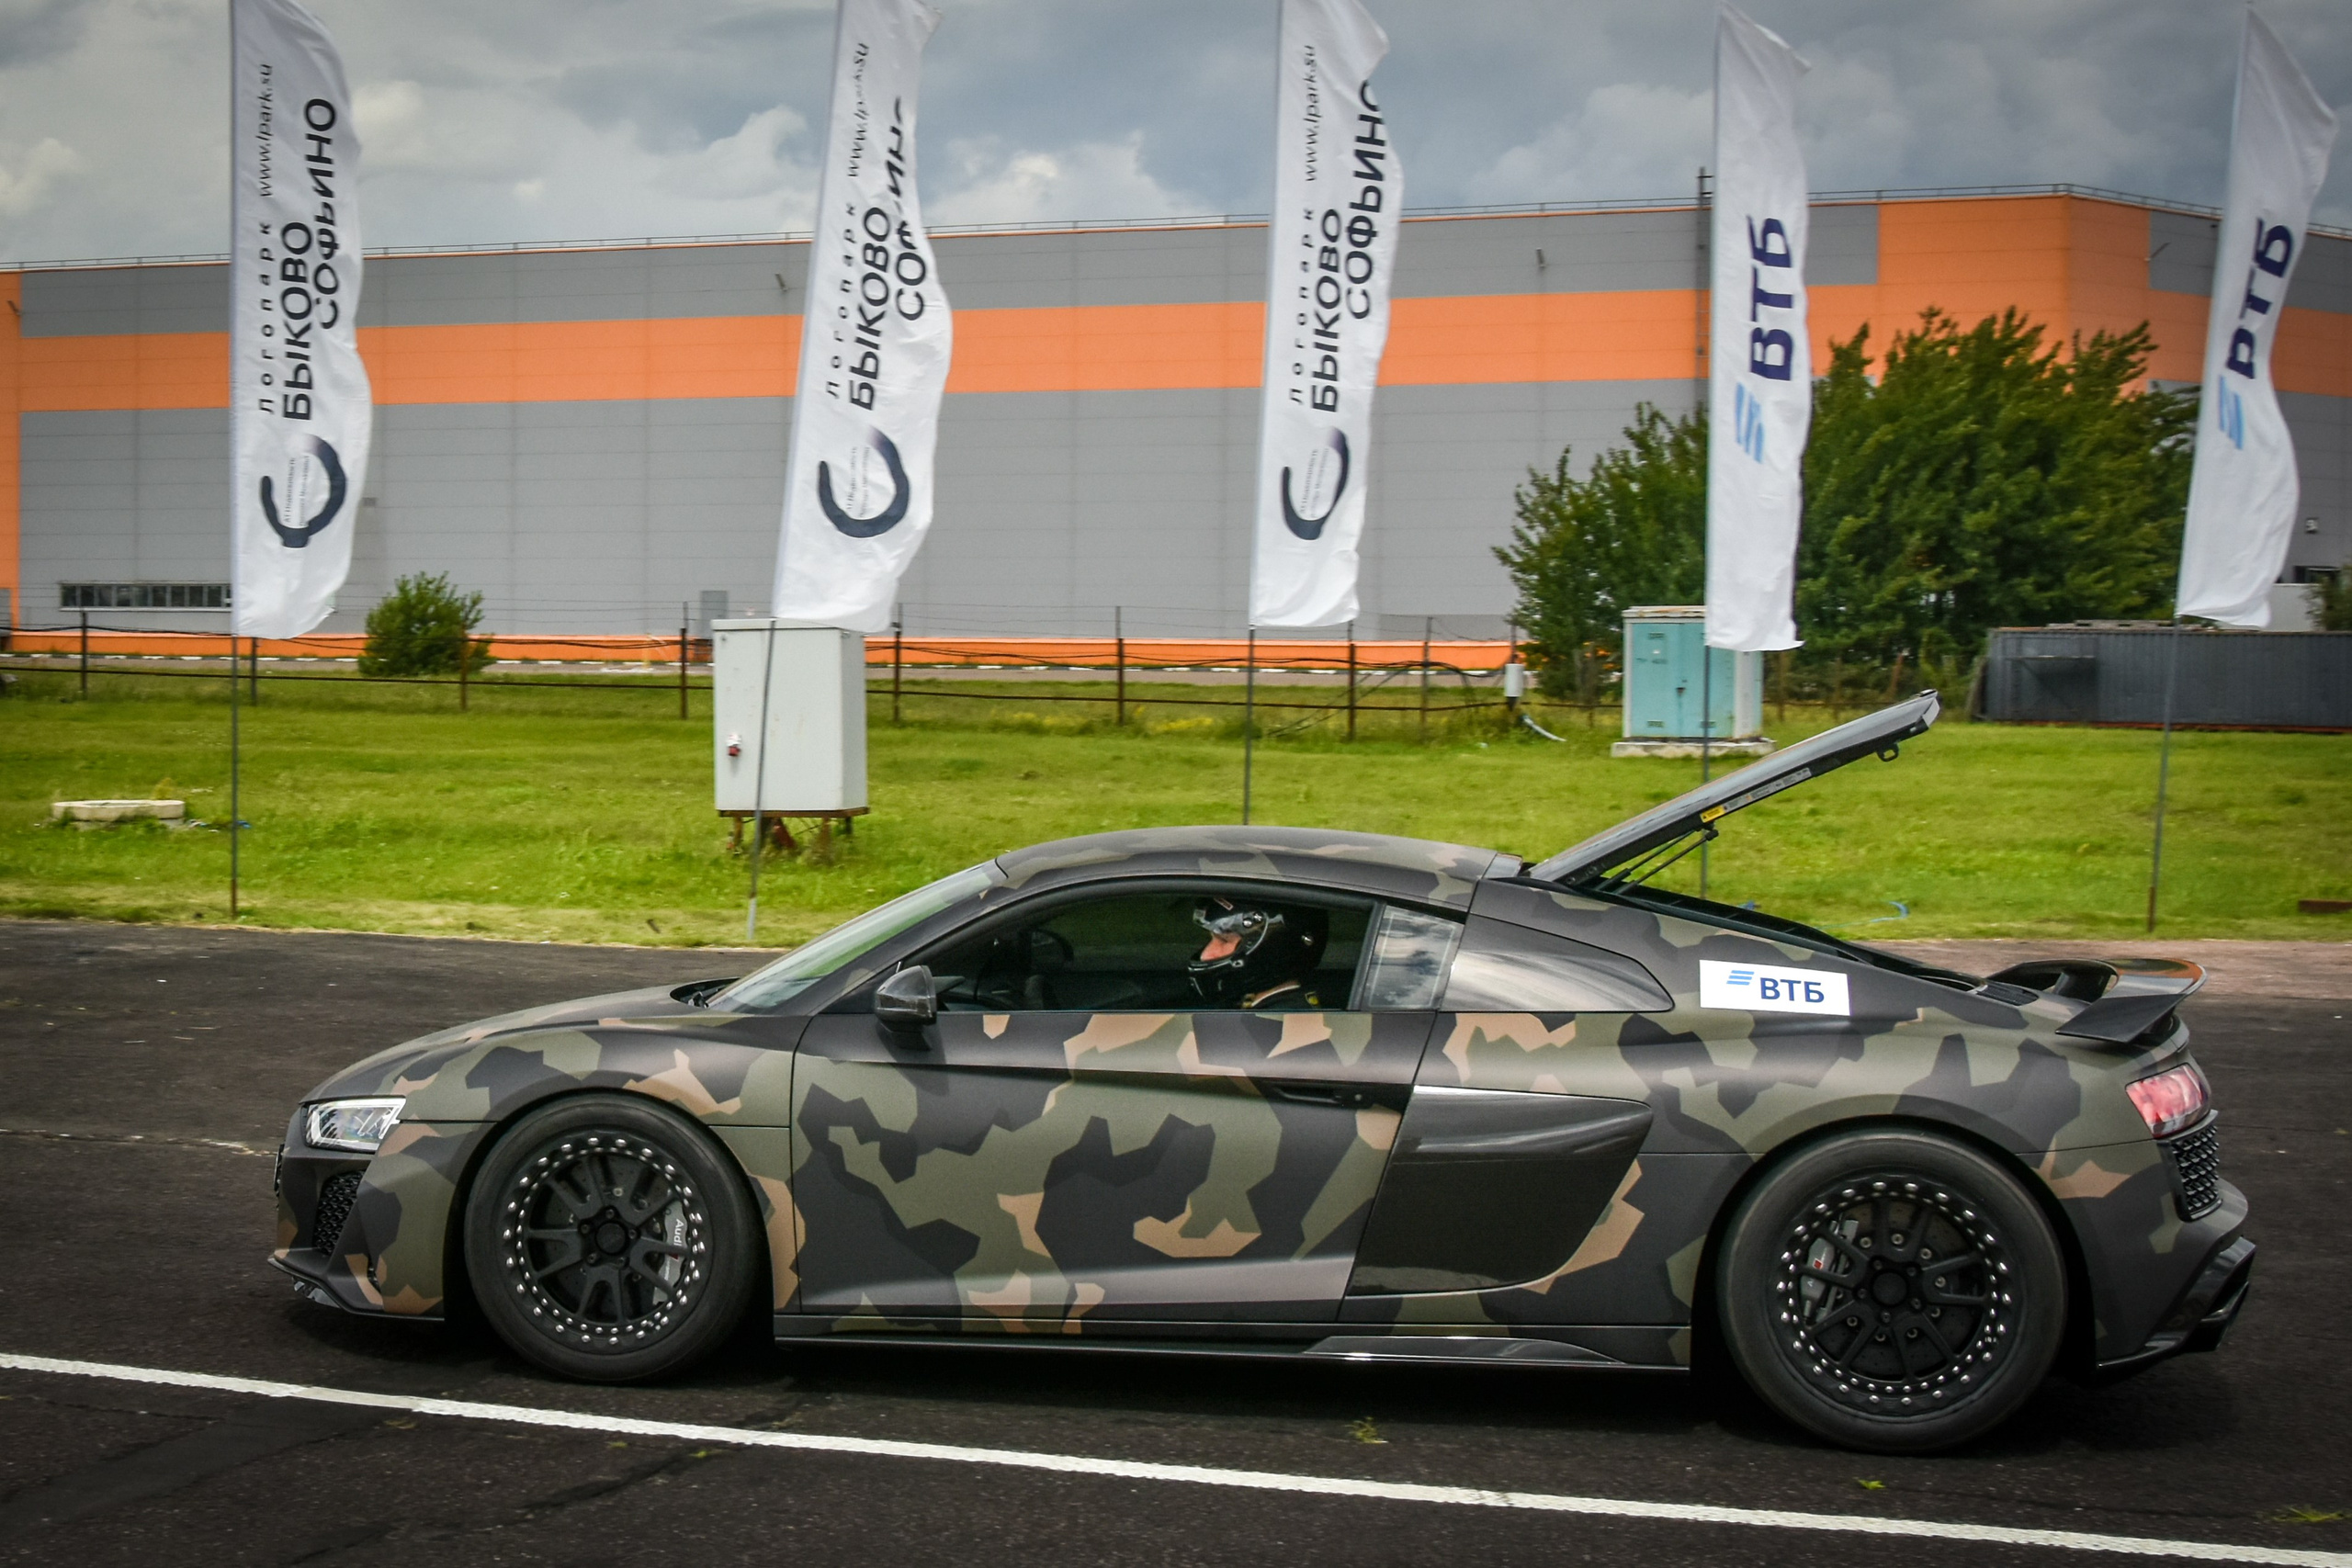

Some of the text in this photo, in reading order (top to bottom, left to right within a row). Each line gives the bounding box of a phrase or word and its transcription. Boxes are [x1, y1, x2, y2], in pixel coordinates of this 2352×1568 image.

[255, 62, 273, 198] www.lpark.su
[1302, 44, 1322, 183] www.lpark.su
[304, 97, 340, 331] СОФЬИНО
[1747, 214, 1794, 381] ВТБ
[279, 221, 314, 422] БЫКОВО
[849, 207, 891, 412] БЫКОВО
[1309, 208, 1342, 413] БЫКОВО
[1760, 977, 1825, 1004] ВТБ
